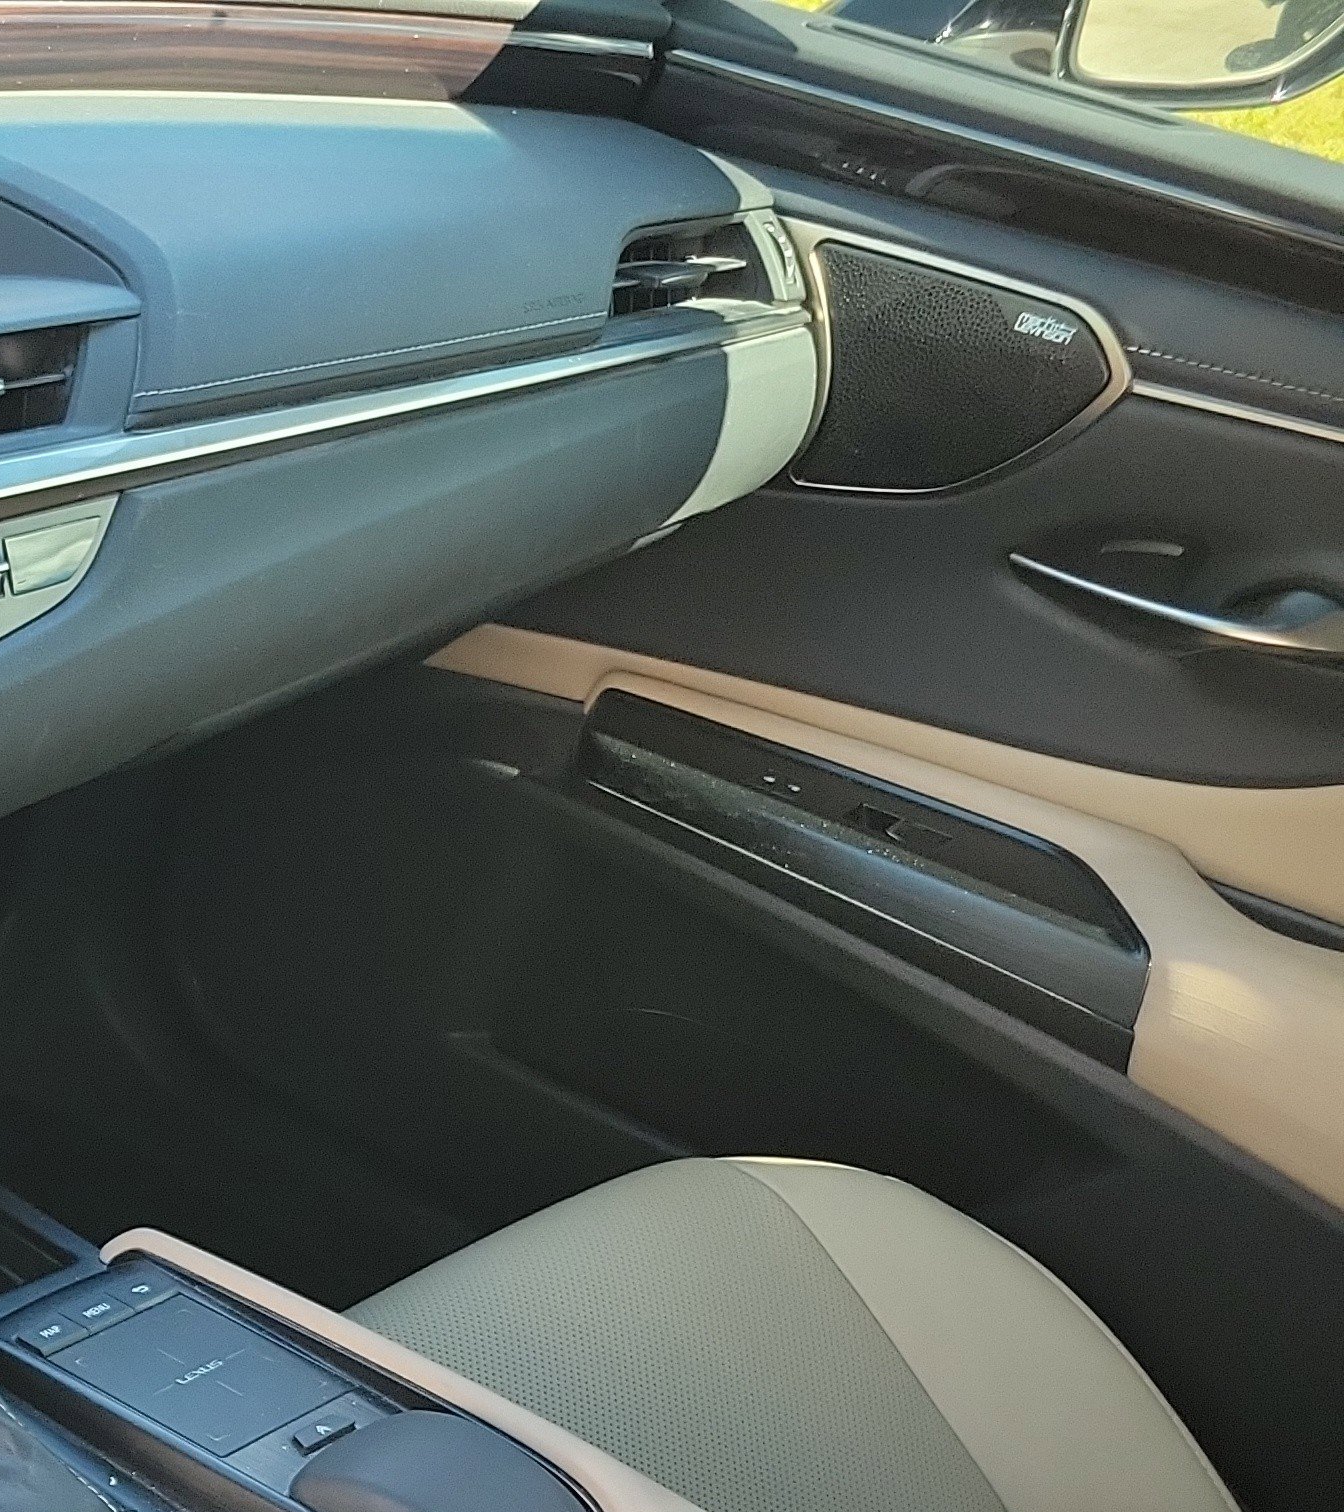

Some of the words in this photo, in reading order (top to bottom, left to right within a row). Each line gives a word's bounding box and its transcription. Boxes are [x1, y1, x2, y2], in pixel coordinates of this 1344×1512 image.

[81, 1302, 111, 1318] MENU
[39, 1324, 62, 1339] MAP
[174, 1359, 224, 1386] LEXUS
